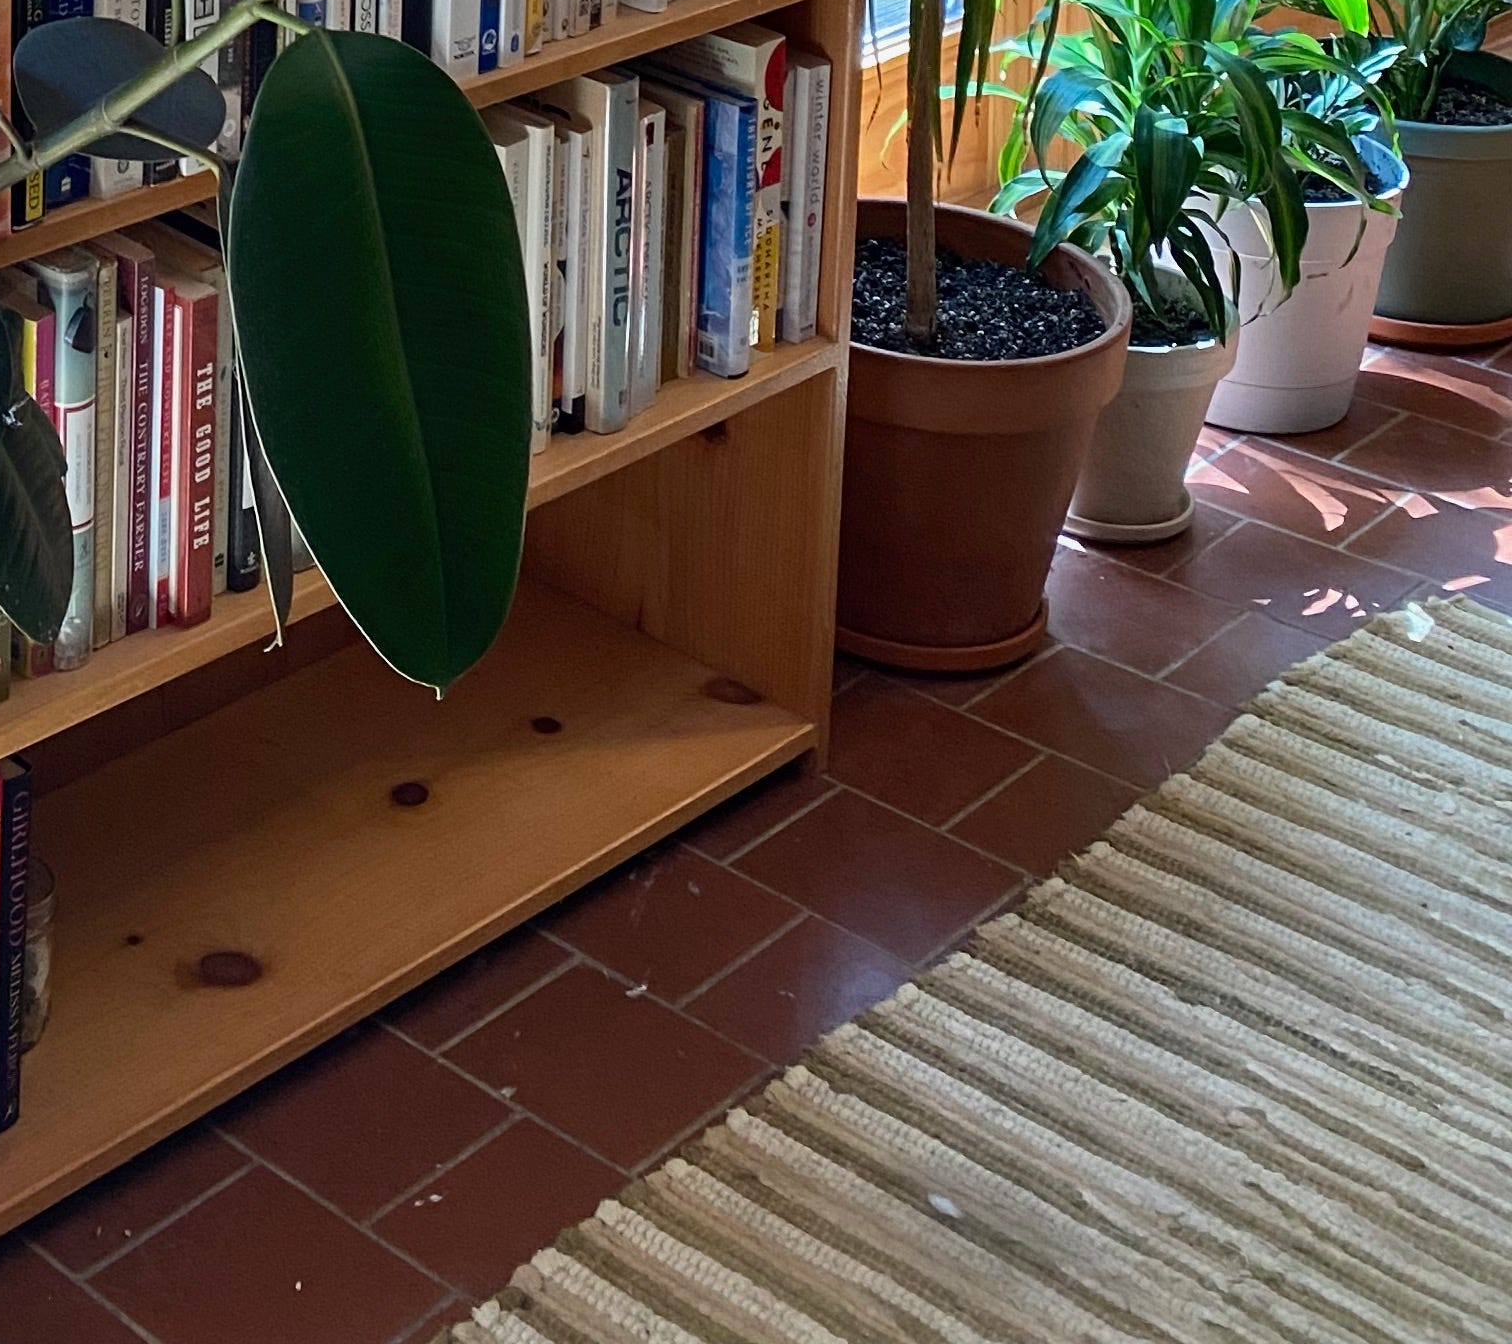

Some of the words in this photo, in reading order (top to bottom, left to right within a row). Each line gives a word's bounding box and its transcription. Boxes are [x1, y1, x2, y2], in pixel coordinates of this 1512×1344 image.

[747, 119, 757, 141] THE
[760, 98, 775, 173] GENE
[813, 78, 826, 141] winter
[28, 172, 40, 210] SED
[745, 151, 755, 199] FUTURE
[809, 151, 822, 205] world
[612, 168, 633, 327] ARCTIC
[744, 223, 753, 246] ICE
[763, 209, 774, 311] SIDDHARTHA
[102, 278, 113, 341] PERRIN
[138, 275, 150, 345] LOGSDON
[137, 360, 149, 397] THE
[195, 362, 214, 410] THE
[135, 402, 148, 494] CONTRARY
[194, 423, 213, 484] GOOD
[133, 501, 147, 572] FARMER
[192, 496, 212, 550] LIFE
[8, 792, 30, 946] GIRLHOOD
[8, 951, 23, 1030] MELISSA
